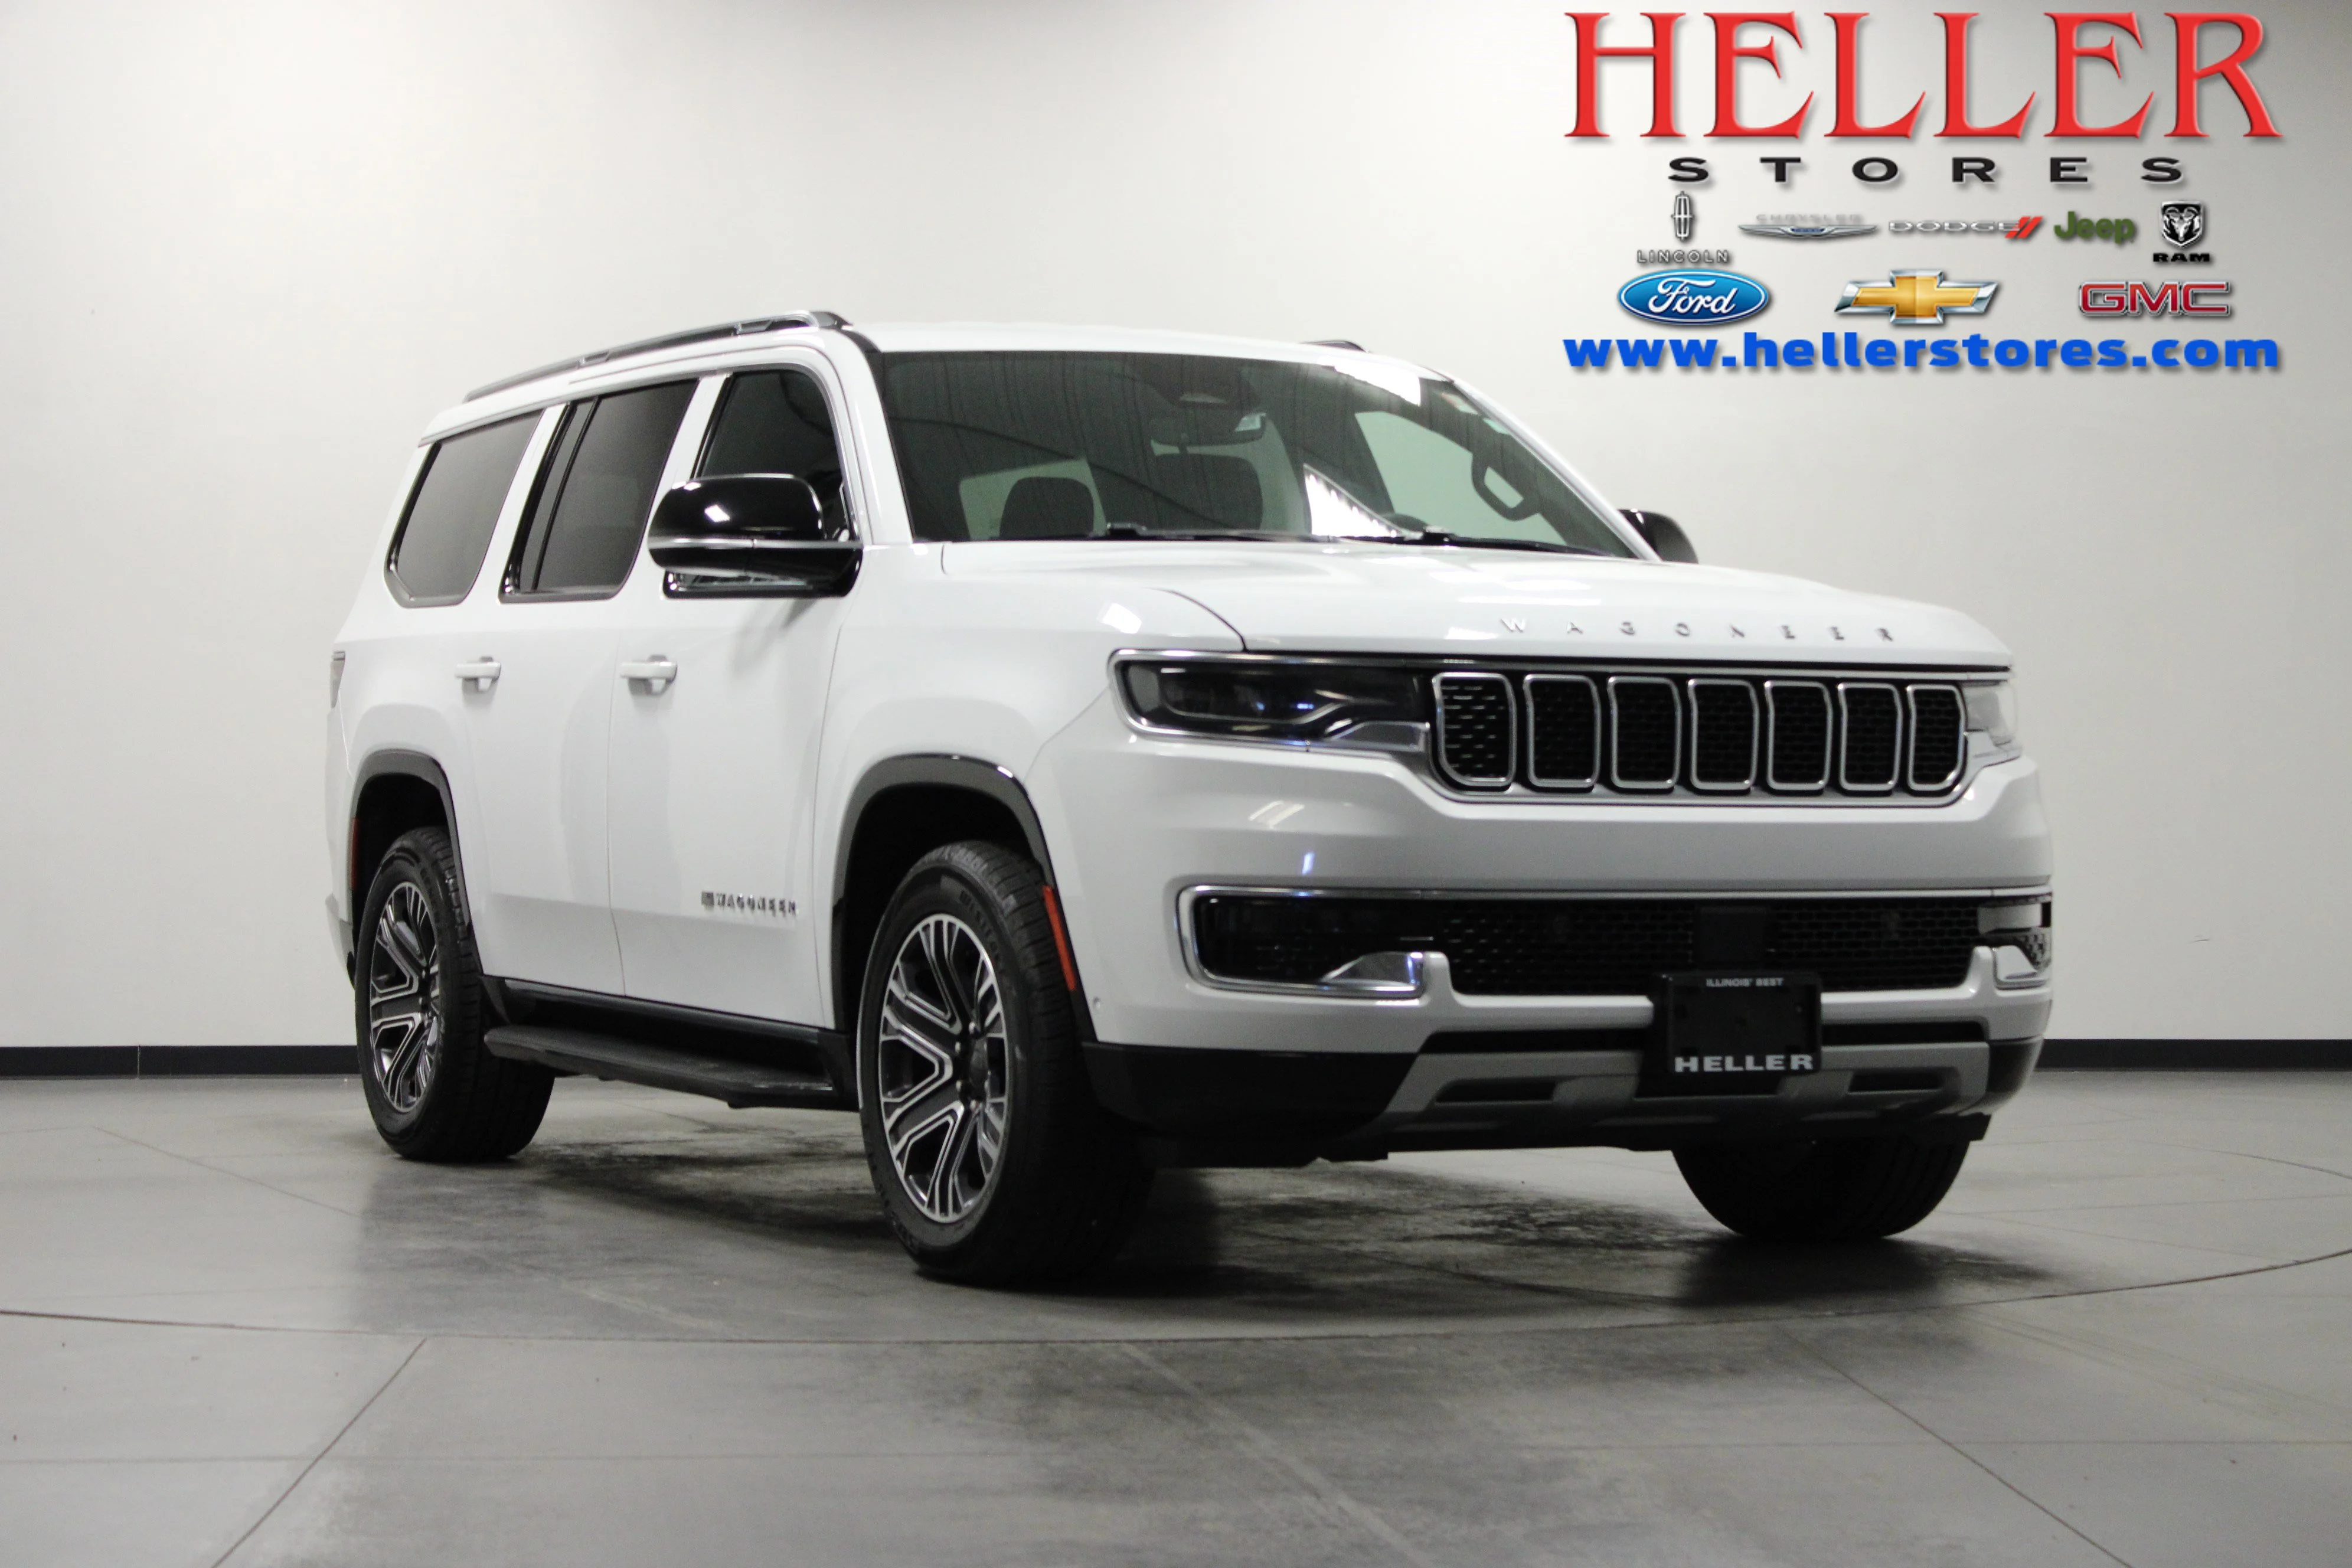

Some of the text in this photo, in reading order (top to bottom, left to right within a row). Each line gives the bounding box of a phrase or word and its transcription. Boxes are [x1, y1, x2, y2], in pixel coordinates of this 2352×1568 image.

[1501, 616, 1894, 642] WAGONEER
[1755, 977, 1785, 986] BEST
[1674, 1054, 1814, 1073] HELLER
